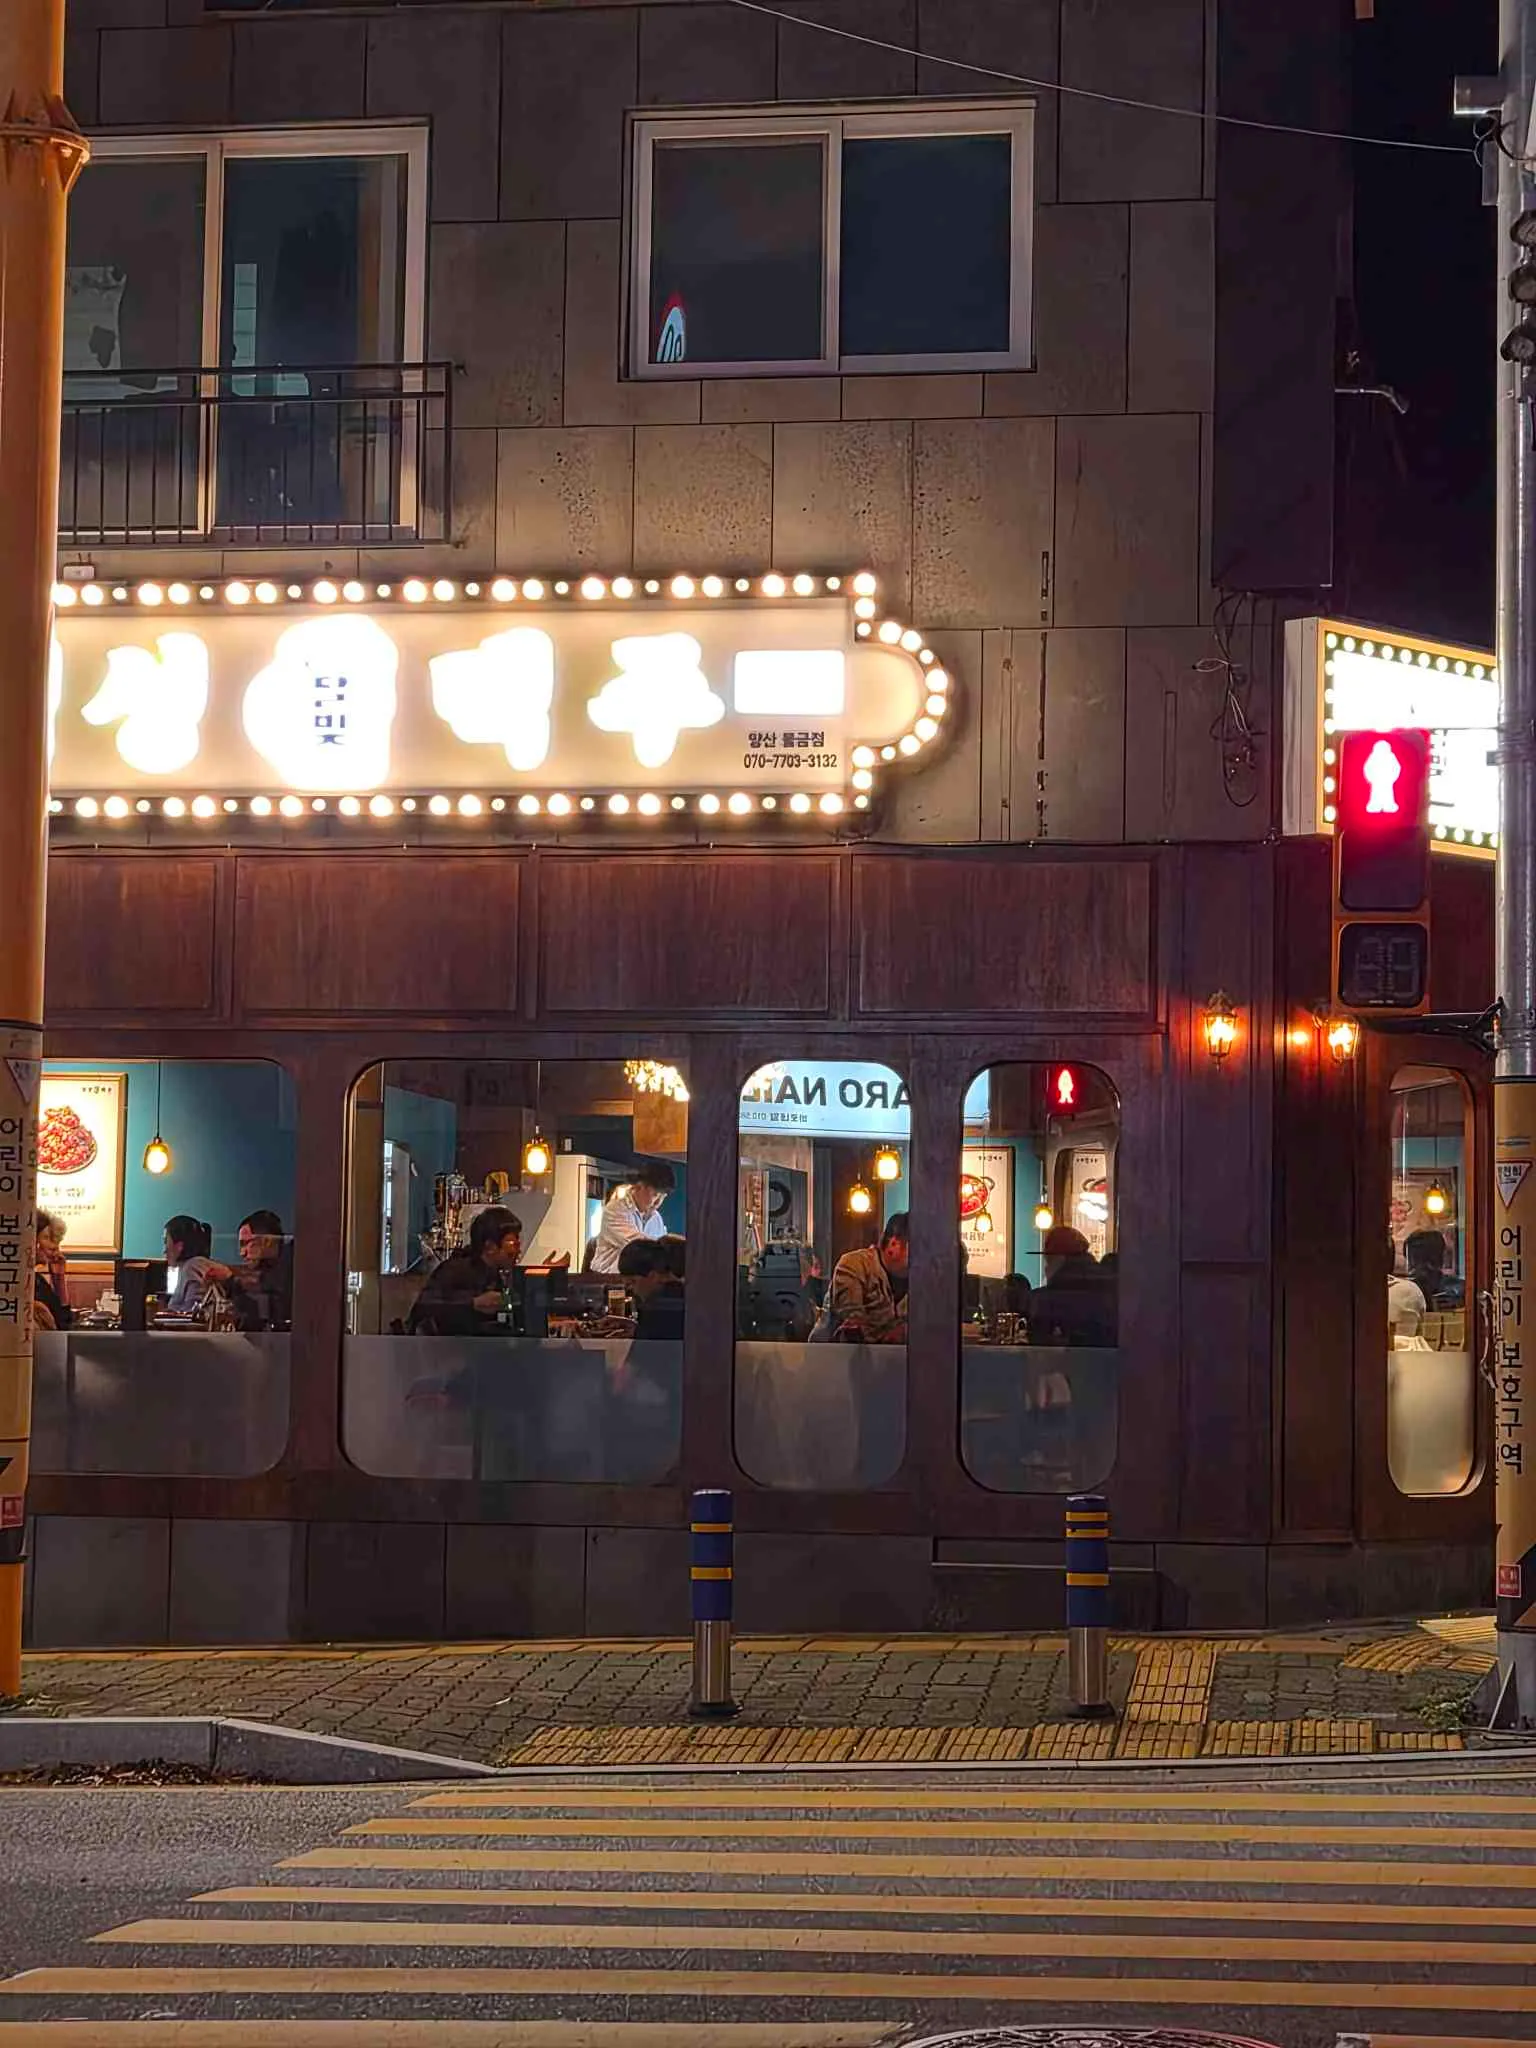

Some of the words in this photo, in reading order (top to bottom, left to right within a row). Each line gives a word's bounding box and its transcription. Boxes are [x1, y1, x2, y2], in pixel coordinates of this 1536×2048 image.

[743, 754, 837, 768] 070-7703-3132
[748, 731, 777, 748] 양산
[0, 1117, 24, 1201] 어린이
[0, 1214, 22, 1324] 보호구역
[1500, 1224, 1523, 1326] 어린이
[1500, 1342, 1523, 1475] 보호구역
